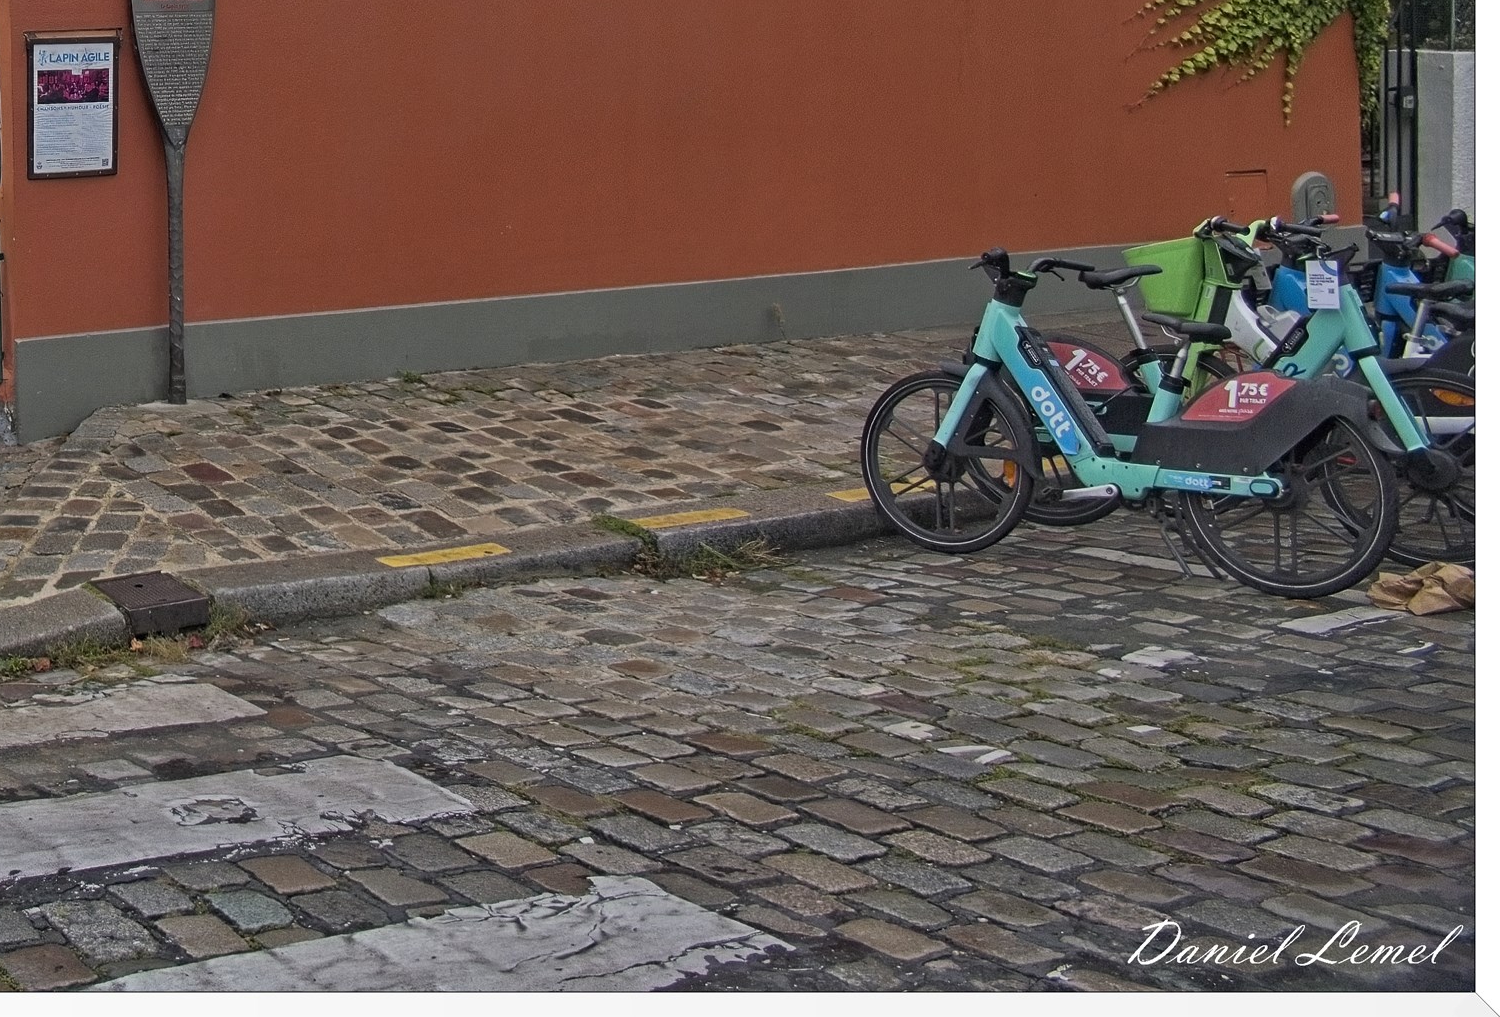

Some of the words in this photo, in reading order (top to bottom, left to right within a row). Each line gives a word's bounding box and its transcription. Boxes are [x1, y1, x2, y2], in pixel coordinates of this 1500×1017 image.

[49, 53, 79, 63] LAPIN
[81, 52, 110, 62] AGILE
[1031, 386, 1071, 439] dott
[1184, 476, 1209, 488] dott
